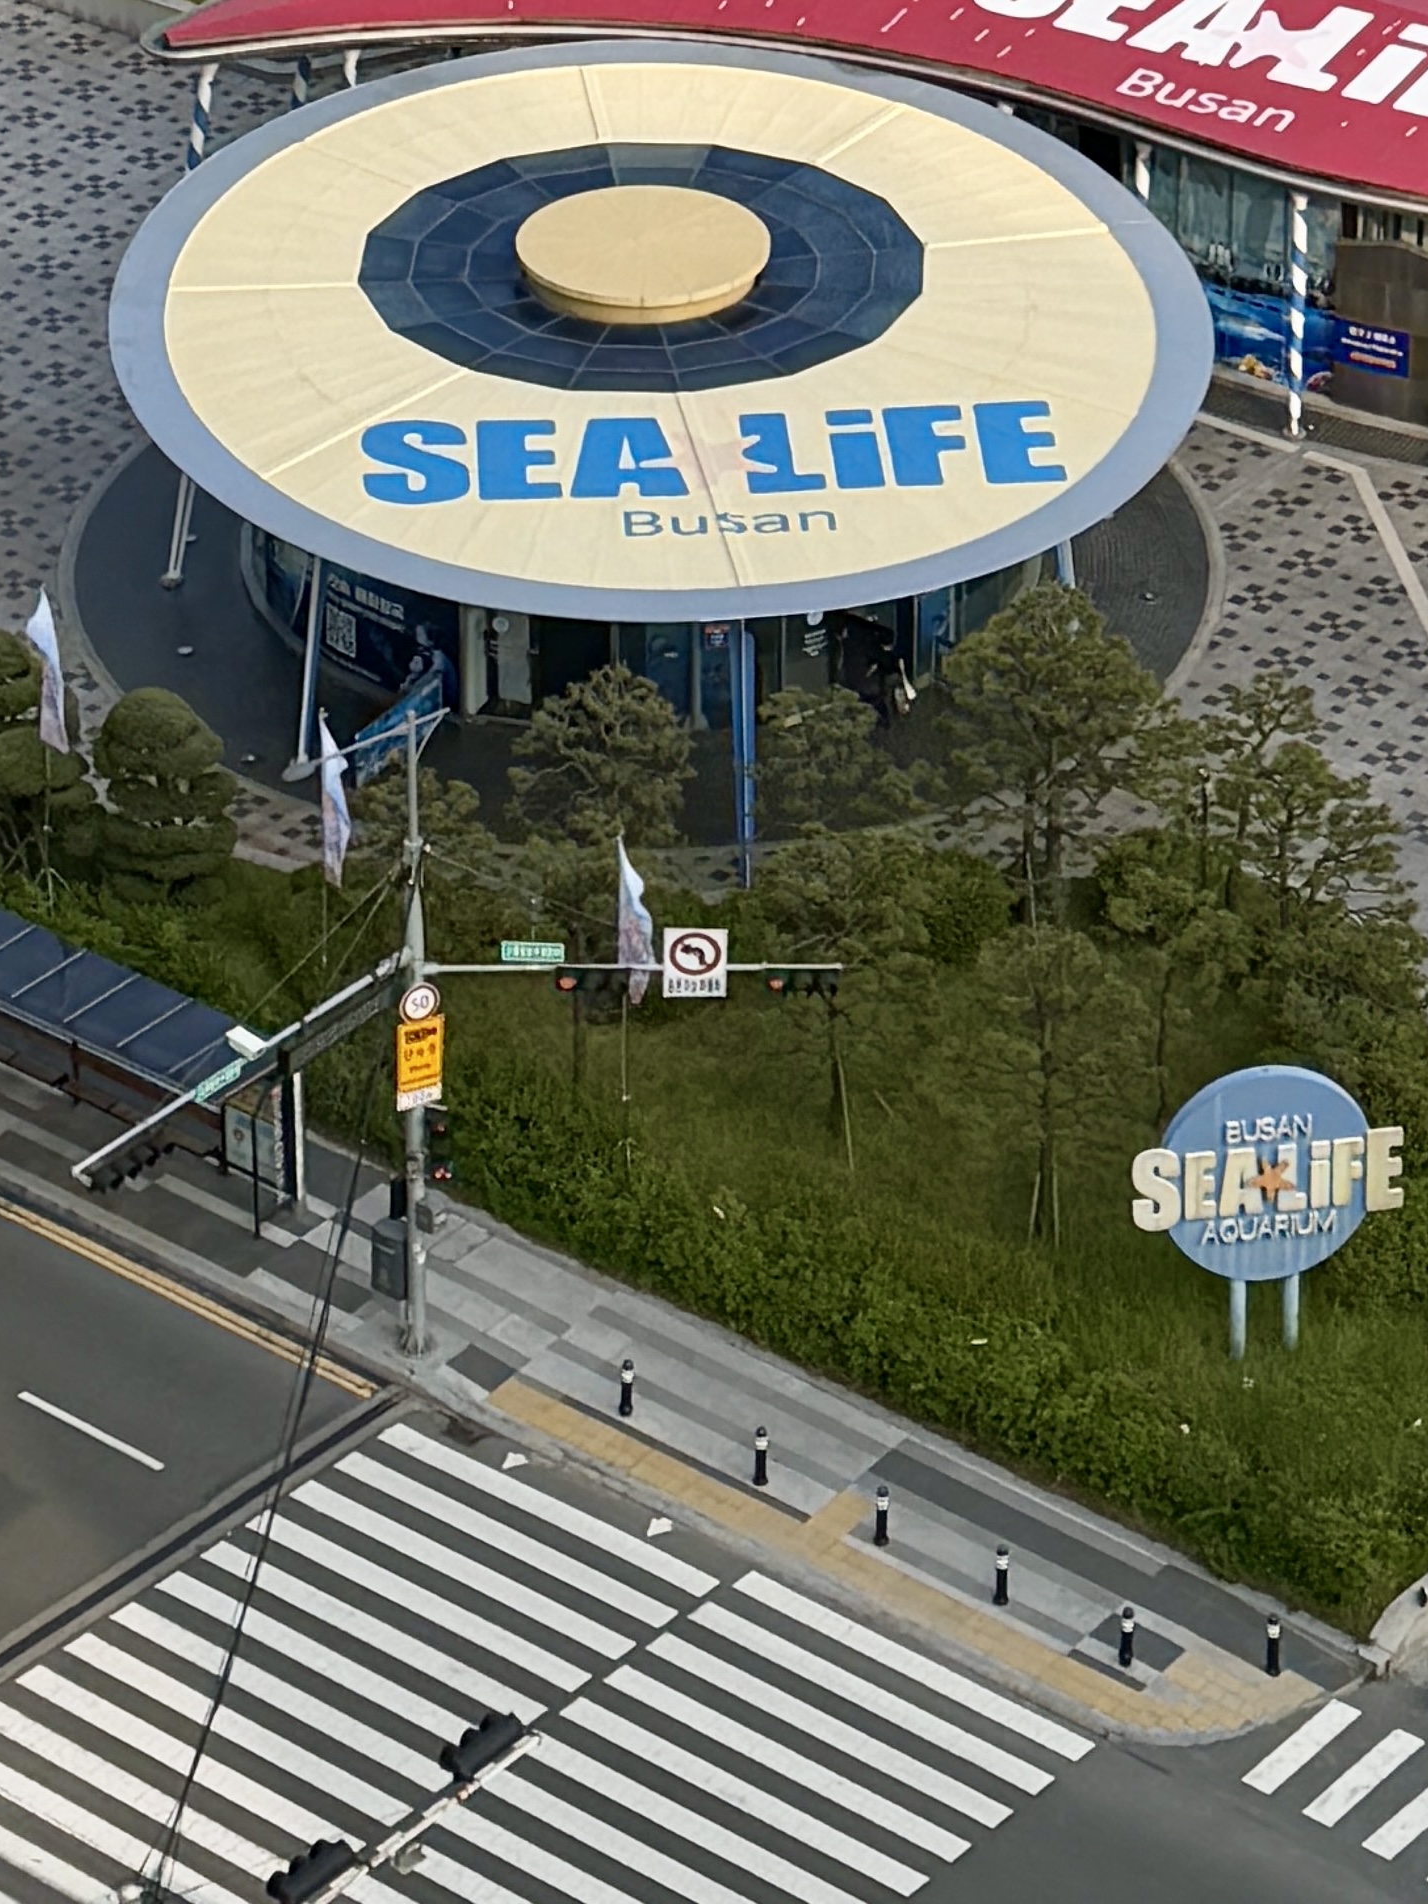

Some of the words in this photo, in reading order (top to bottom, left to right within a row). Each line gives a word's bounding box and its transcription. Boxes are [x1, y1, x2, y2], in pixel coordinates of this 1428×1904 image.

[1115, 67, 1296, 133] Busan
[360, 417, 690, 505] SEA
[623, 507, 838, 537] Busan
[1225, 1113, 1313, 1143] BUSAN
[1132, 1147, 1264, 1232] SEA
[1201, 1209, 1338, 1246] AQUARIUM
